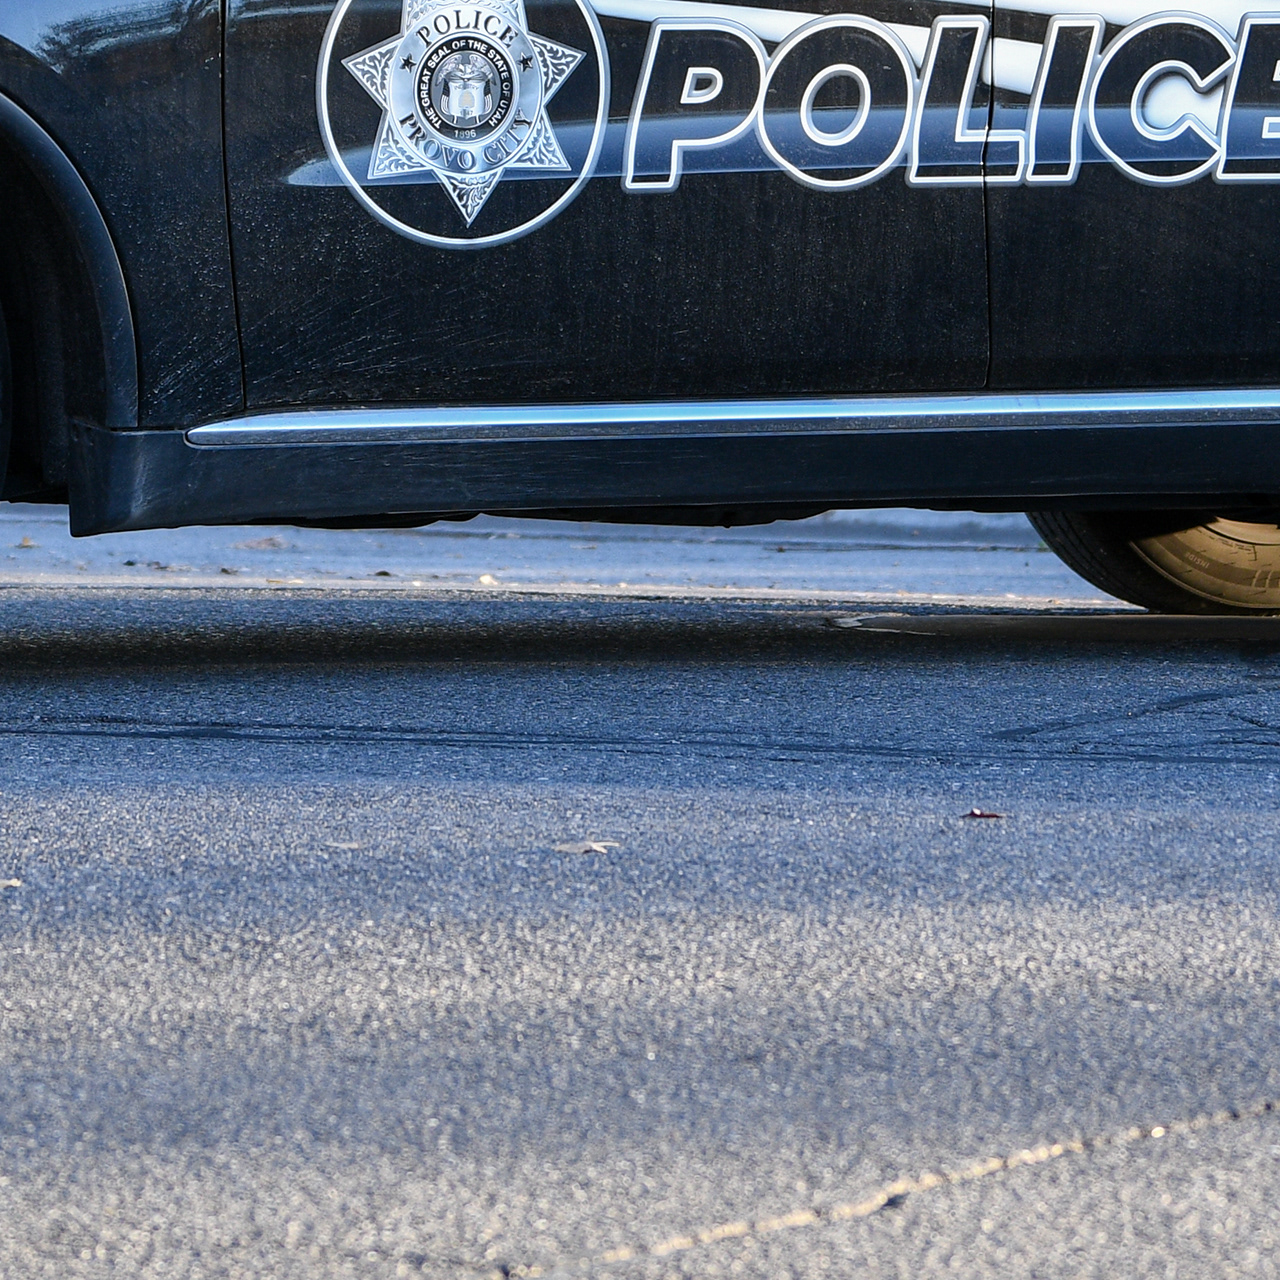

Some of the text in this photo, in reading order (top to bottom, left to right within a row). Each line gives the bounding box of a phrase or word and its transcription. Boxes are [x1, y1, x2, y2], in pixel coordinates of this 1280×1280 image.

[415, 9, 519, 49] POLICE
[420, 39, 512, 130] THE GREAT SEAL OF THE STATE OF UTAH
[398, 108, 533, 170] PROVO CITY
[453, 128, 478, 139] 1896
